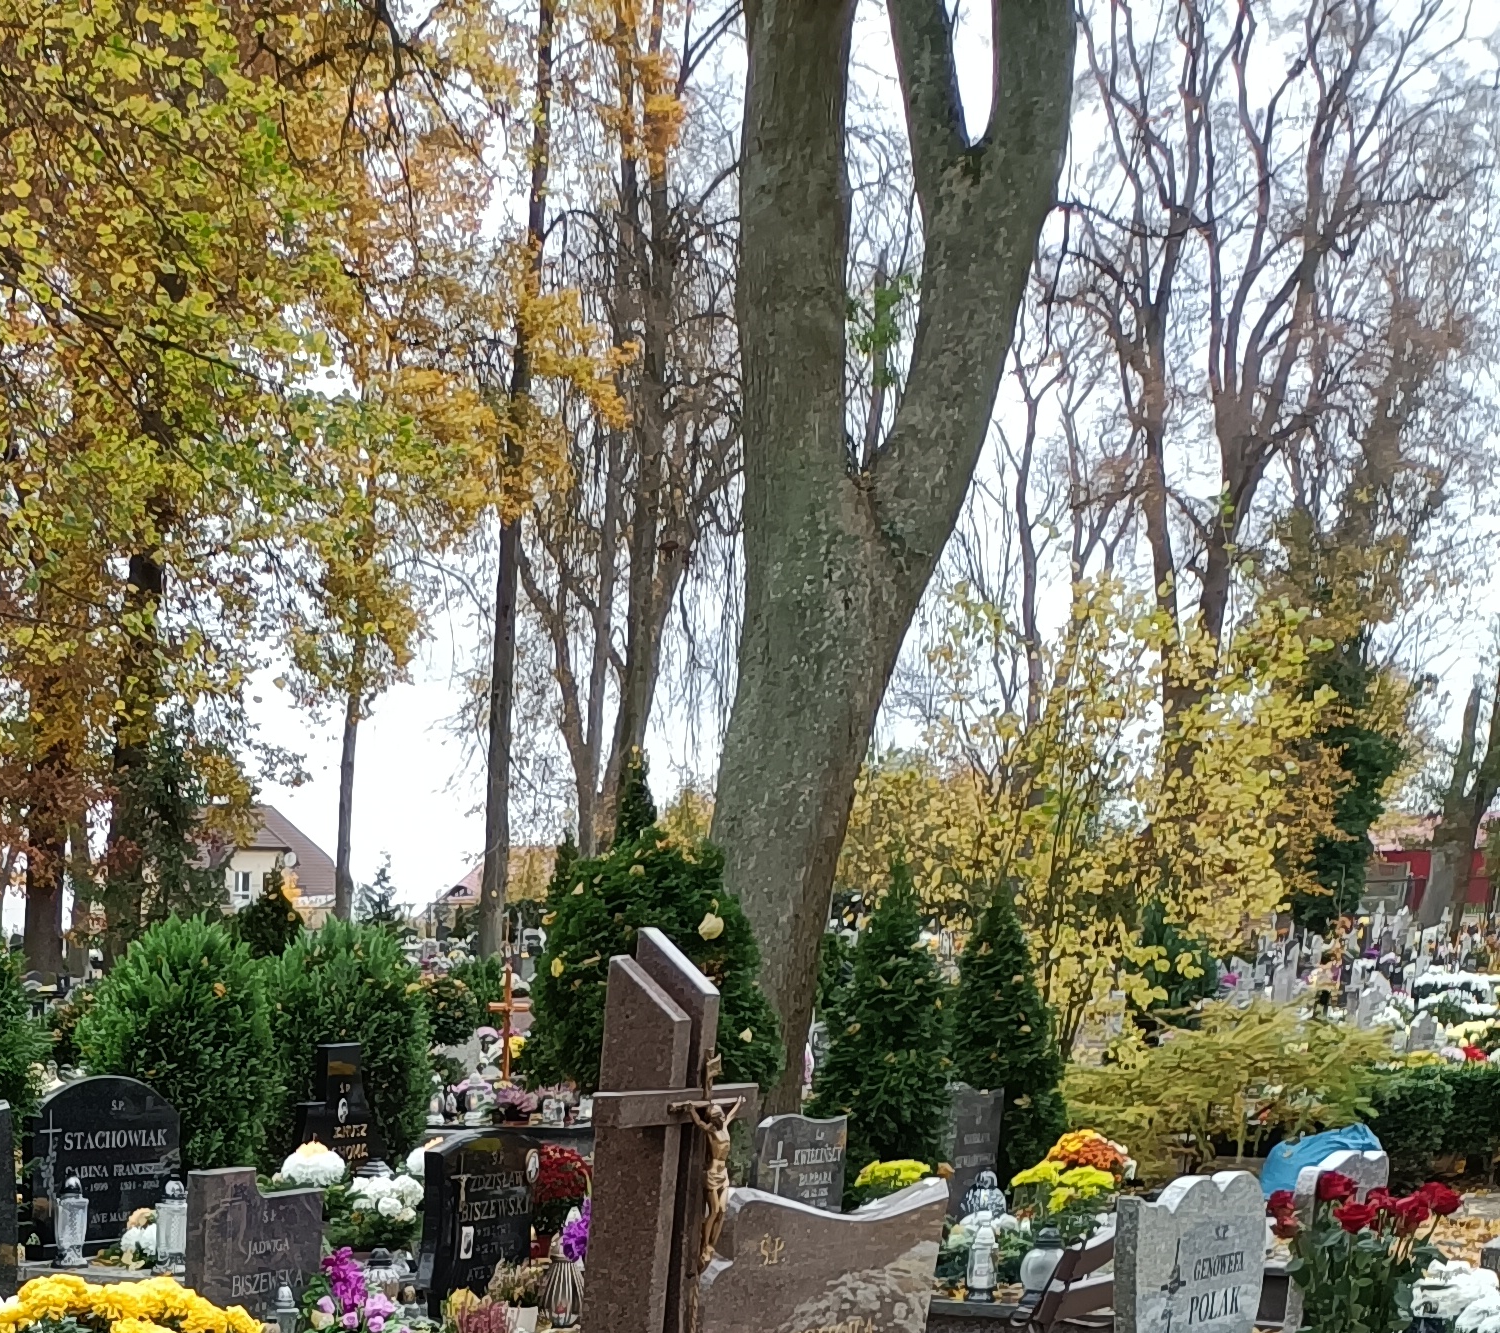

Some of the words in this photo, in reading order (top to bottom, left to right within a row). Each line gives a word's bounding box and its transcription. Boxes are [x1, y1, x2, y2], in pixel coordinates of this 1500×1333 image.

[63, 1128, 168, 1151] STACHOWIAK
[459, 1193, 533, 1223] BISZEWSKI
[244, 1237, 290, 1265] JADWIGA
[1188, 1285, 1242, 1325] POLAK
